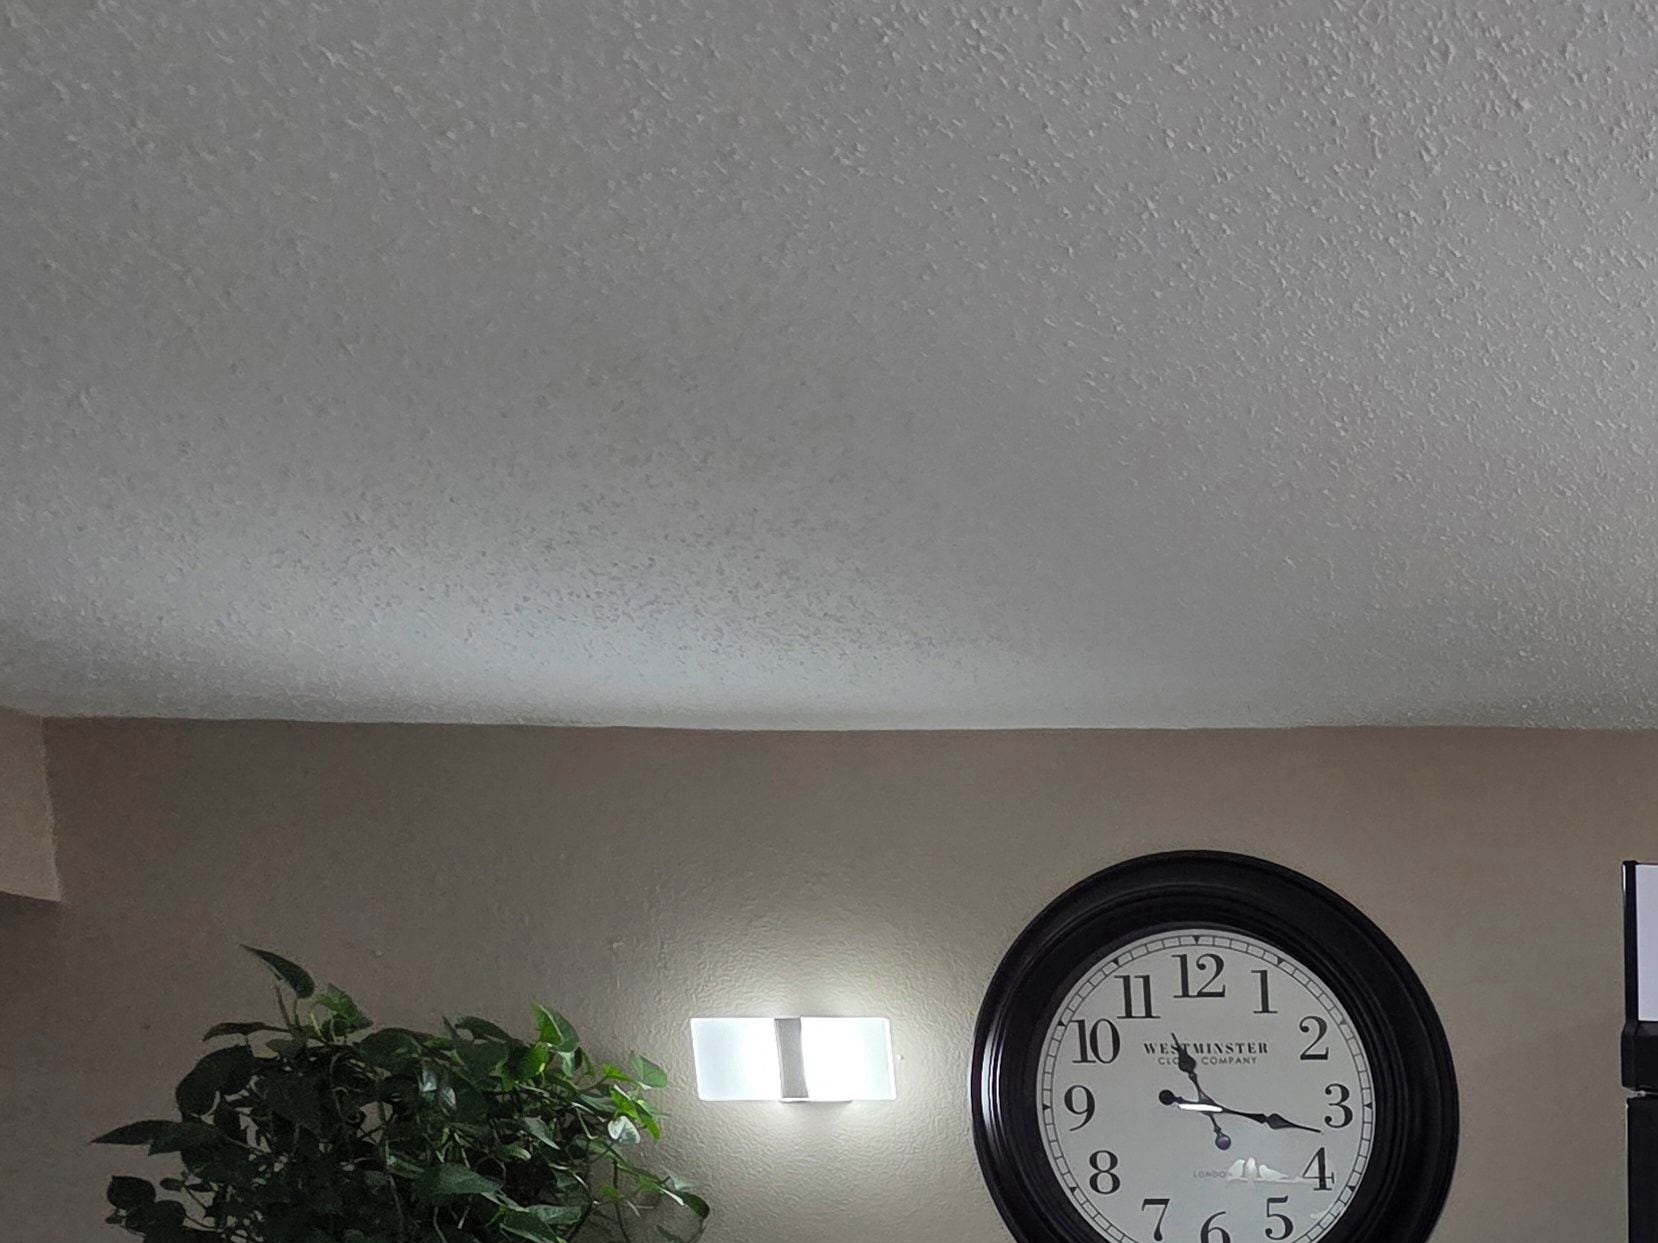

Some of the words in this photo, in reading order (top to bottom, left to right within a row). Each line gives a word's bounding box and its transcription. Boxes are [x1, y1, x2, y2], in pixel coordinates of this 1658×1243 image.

[1114, 974, 1161, 1019] 11
[1171, 953, 1226, 998] 12
[1251, 969, 1278, 1014] 1
[1070, 1018, 1120, 1064] 10
[1200, 1056, 1257, 1065] COMPANY
[1299, 1016, 1329, 1060] 2
[1064, 1084, 1096, 1131] 9
[1324, 1083, 1354, 1128] 3
[1089, 1150, 1121, 1194] 8
[1302, 1147, 1335, 1191] 4
[1141, 1198, 1170, 1241] 7
[1264, 1195, 1294, 1240] 5
